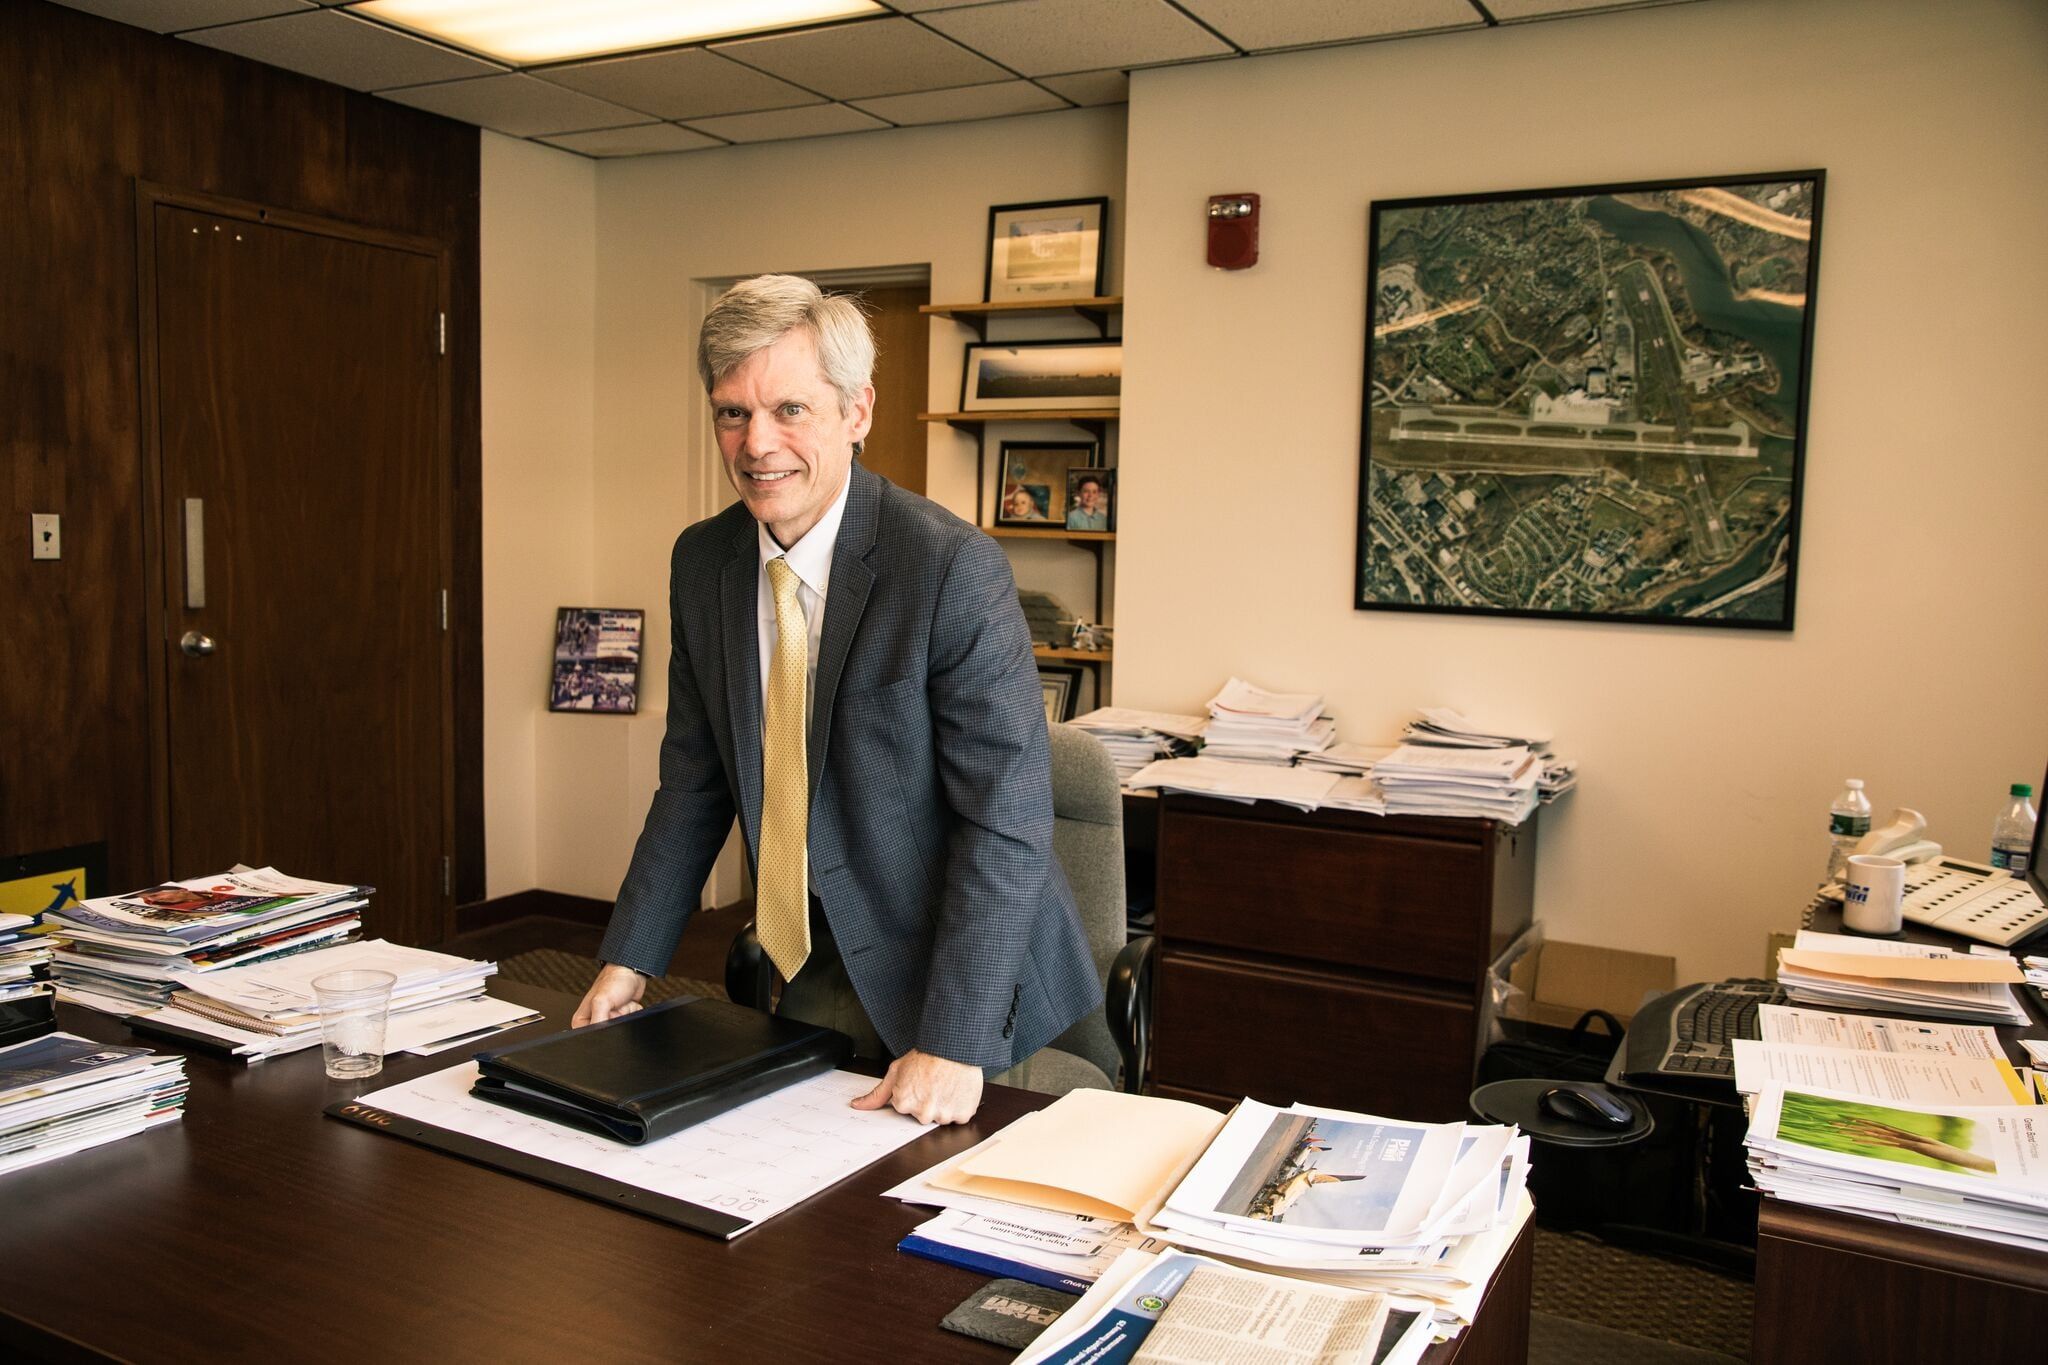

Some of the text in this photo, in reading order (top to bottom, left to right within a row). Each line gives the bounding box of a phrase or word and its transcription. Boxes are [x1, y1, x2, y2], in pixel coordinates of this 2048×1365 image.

[702, 1193, 758, 1213] OCT
[990, 1226, 1069, 1247] Slope Stabilization
[1072, 1234, 1092, 1244] and
